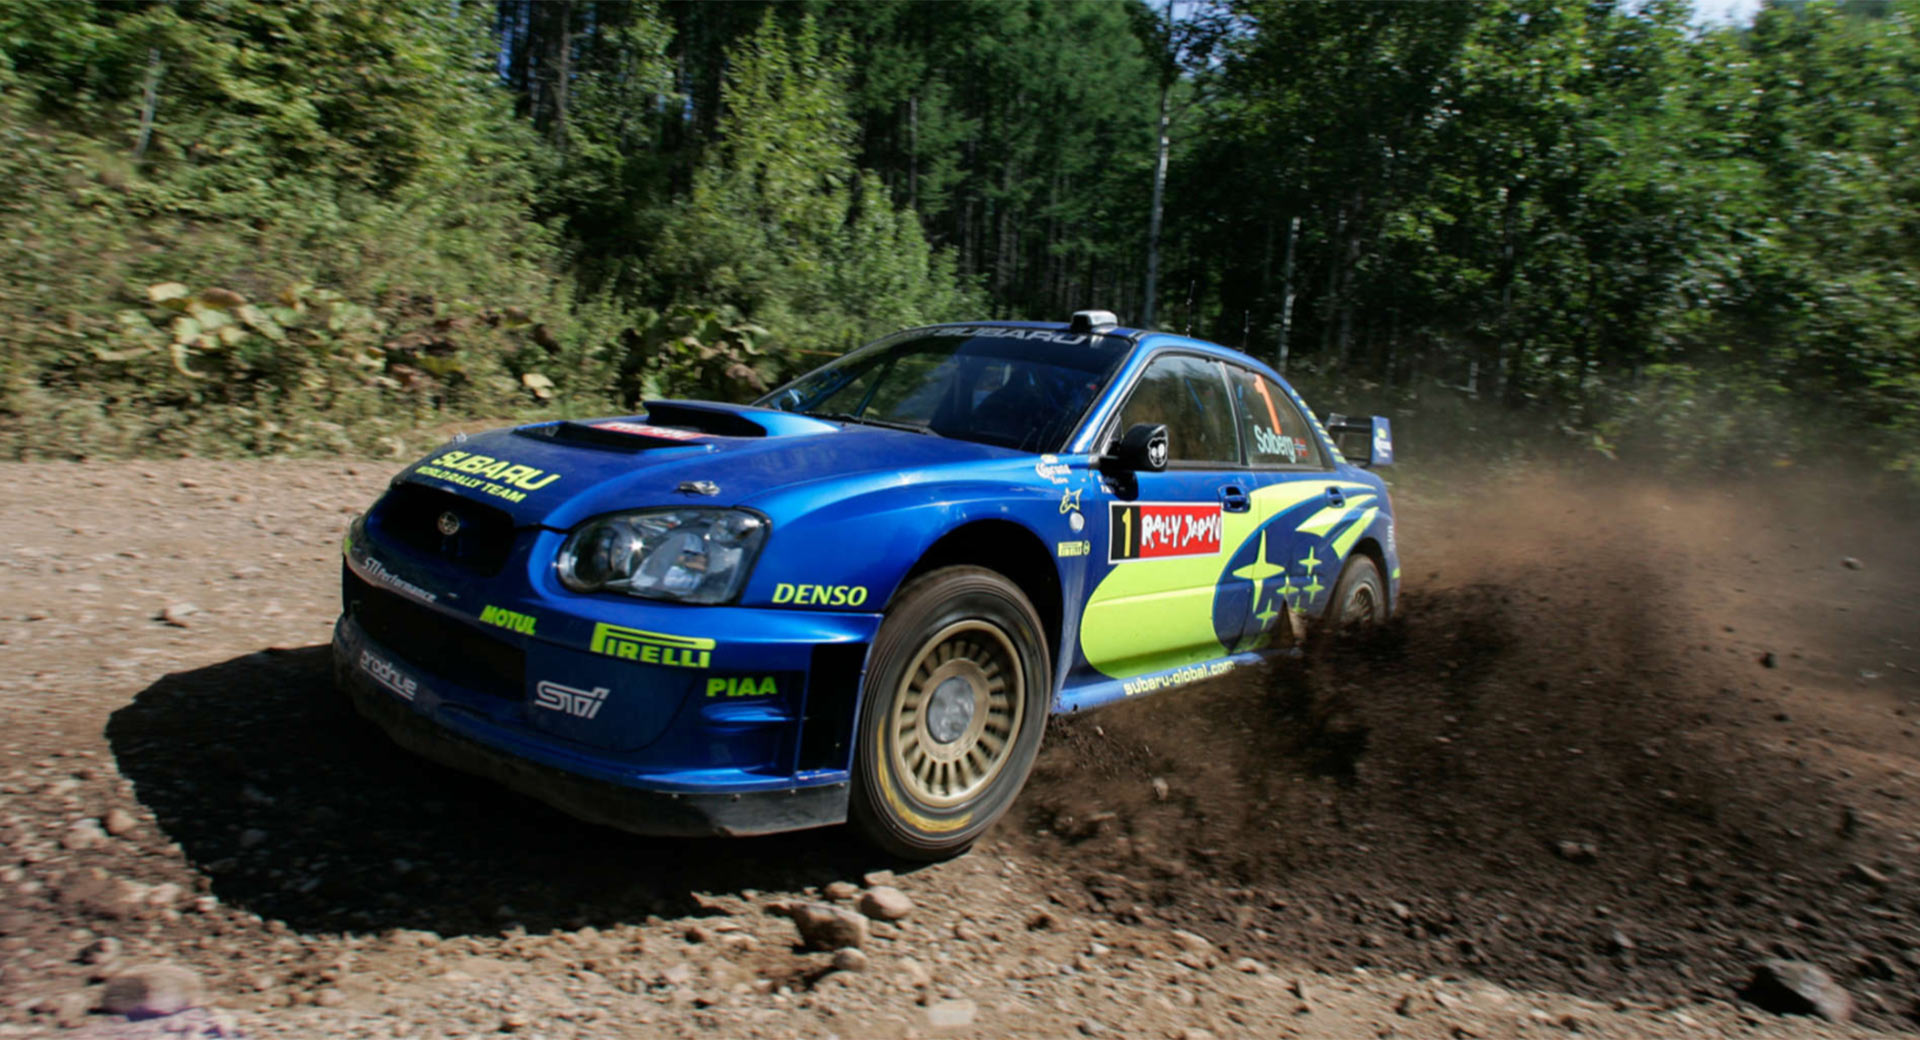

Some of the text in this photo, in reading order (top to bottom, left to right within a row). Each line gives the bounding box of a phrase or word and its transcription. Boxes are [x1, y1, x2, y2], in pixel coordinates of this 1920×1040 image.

[932, 327, 1087, 345] SUBARU
[1253, 373, 1282, 435] 1
[1253, 424, 1296, 464] Solberg
[415, 466, 527, 503] WORLD RALLY TEAM
[431, 450, 561, 490] SUBARU
[1122, 507, 1132, 557] 1
[1141, 514, 1182, 550] RALLY
[771, 583, 868, 606] DENSO
[479, 604, 537, 636] MOTUL
[590, 622, 717, 668] PIRELLI
[706, 676, 778, 697] PIAA
[1123, 660, 1235, 696] subaru-global.com
